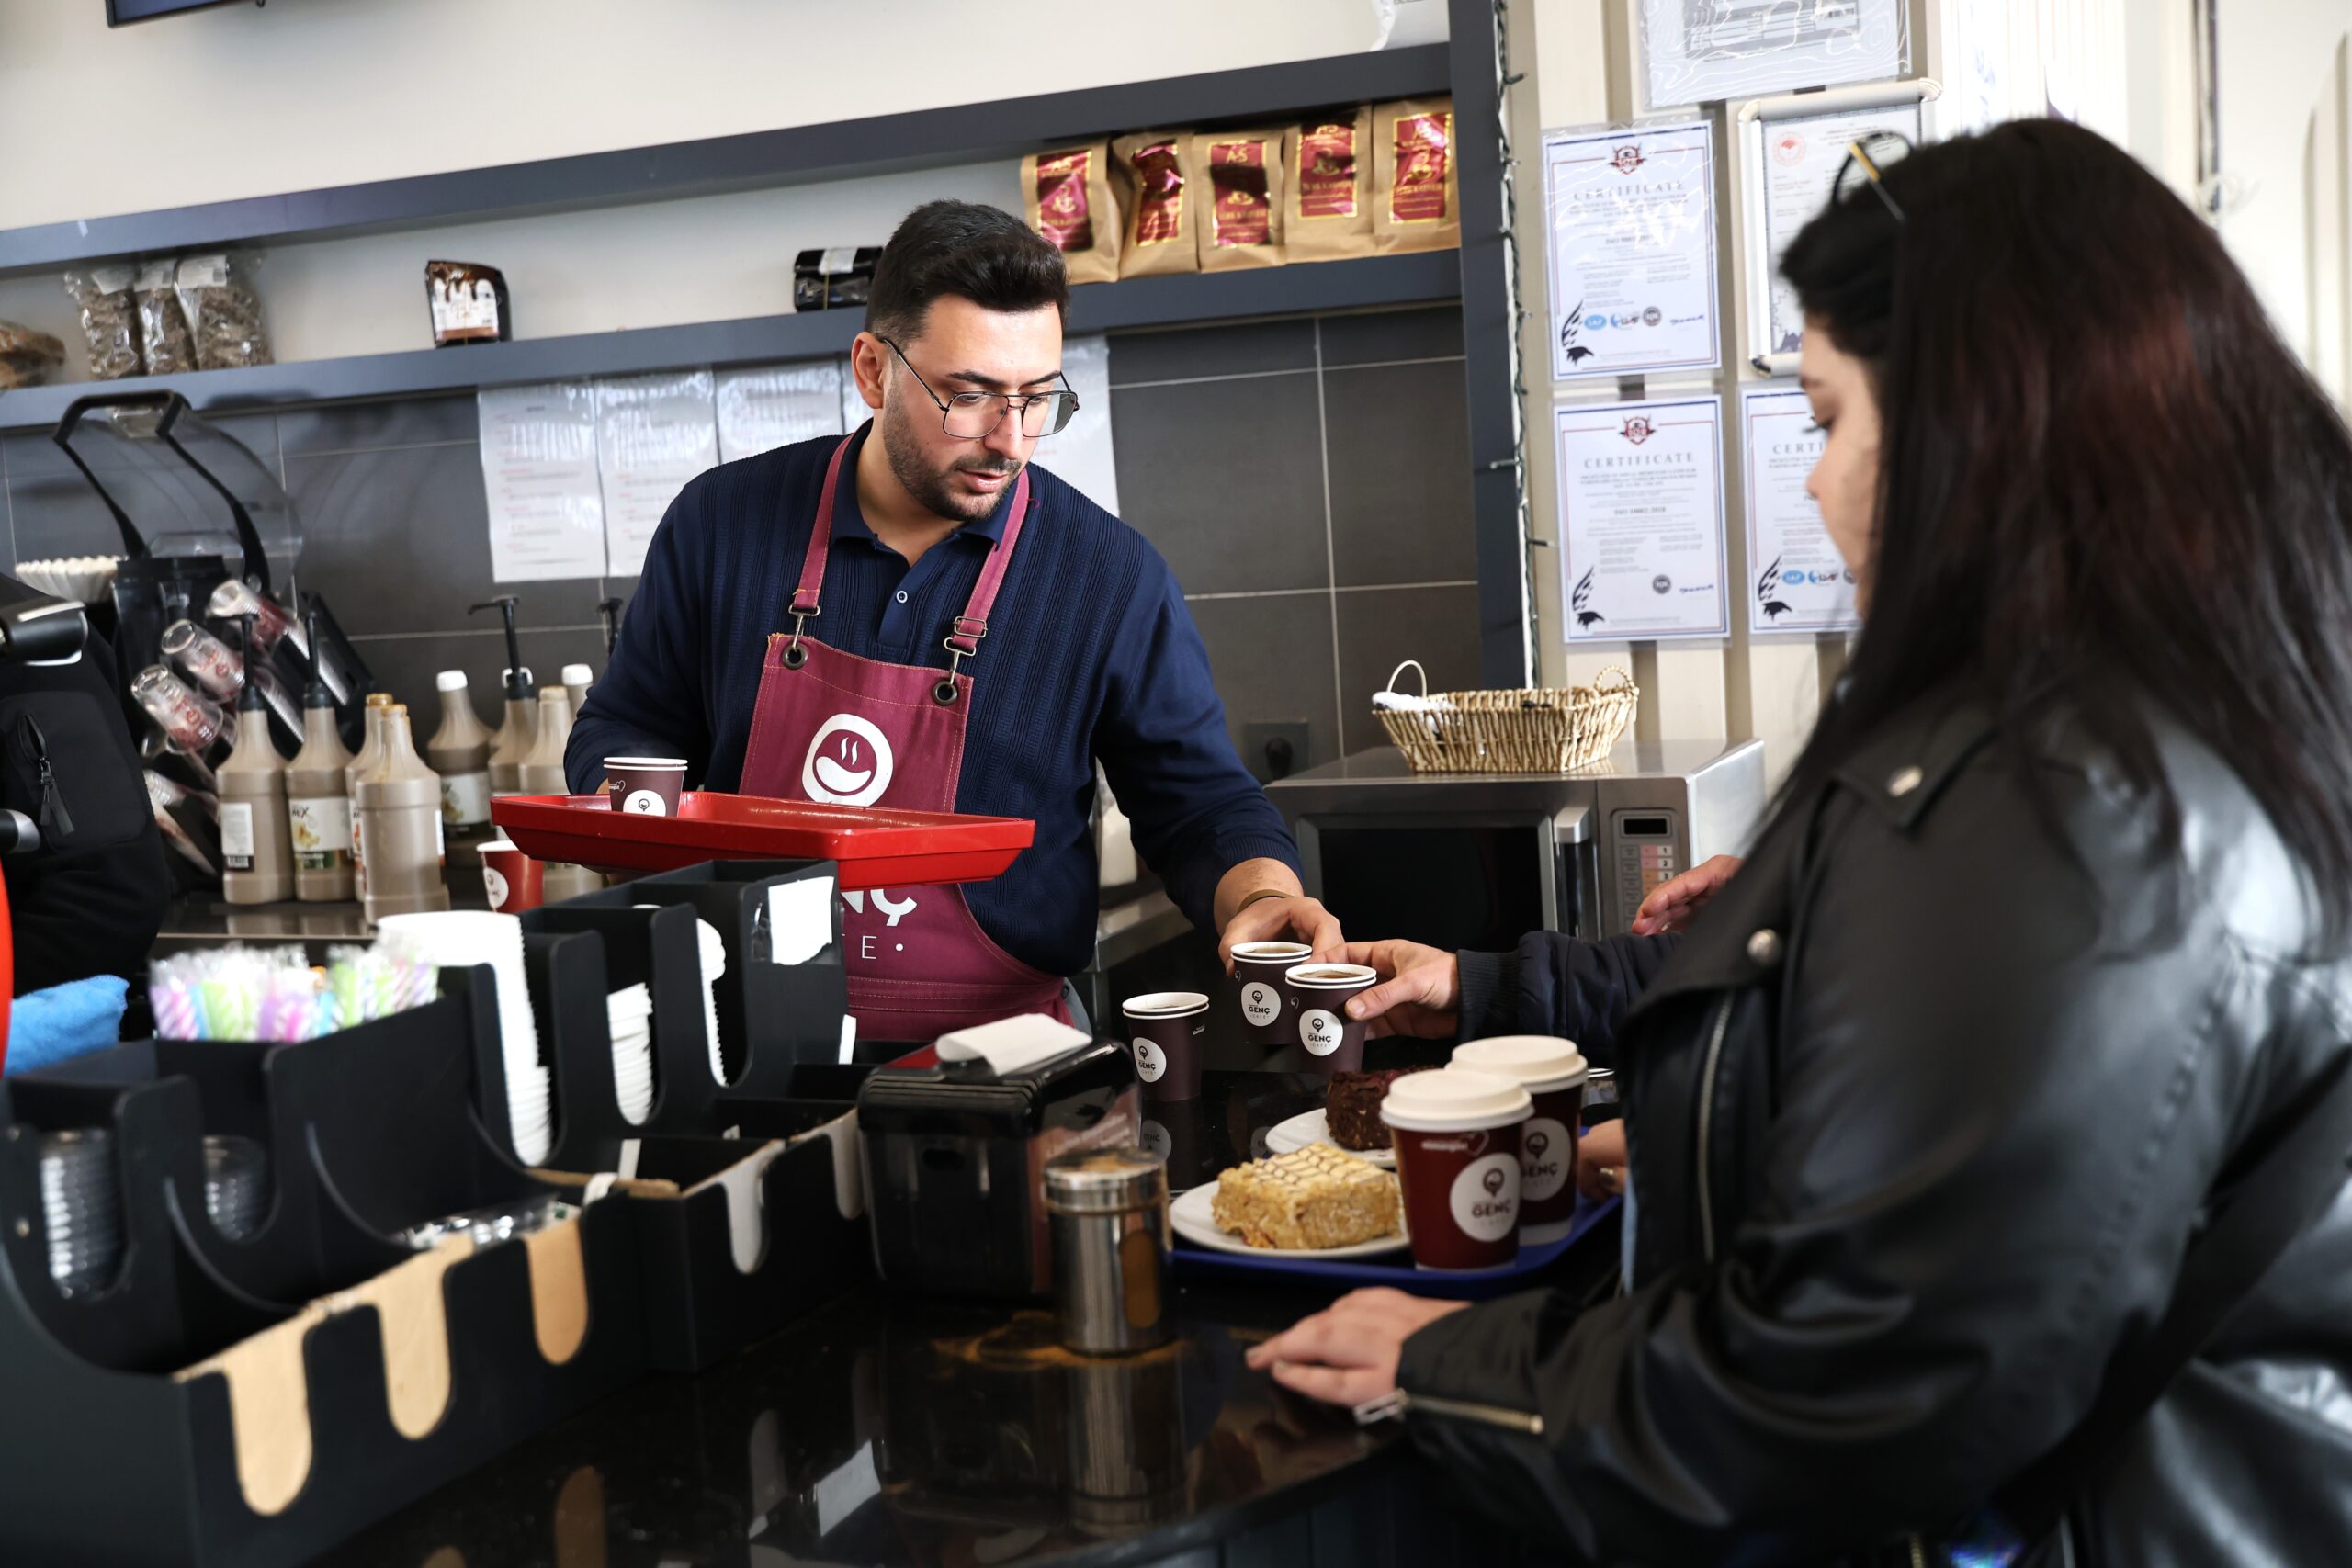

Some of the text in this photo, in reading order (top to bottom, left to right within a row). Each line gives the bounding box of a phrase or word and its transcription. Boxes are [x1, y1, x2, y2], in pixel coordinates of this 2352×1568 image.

[1584, 452, 1694, 469] CERTIFICATE
[1249, 1006, 1271, 1015] GENÇ
[1308, 1034, 1332, 1043] GENÇ
